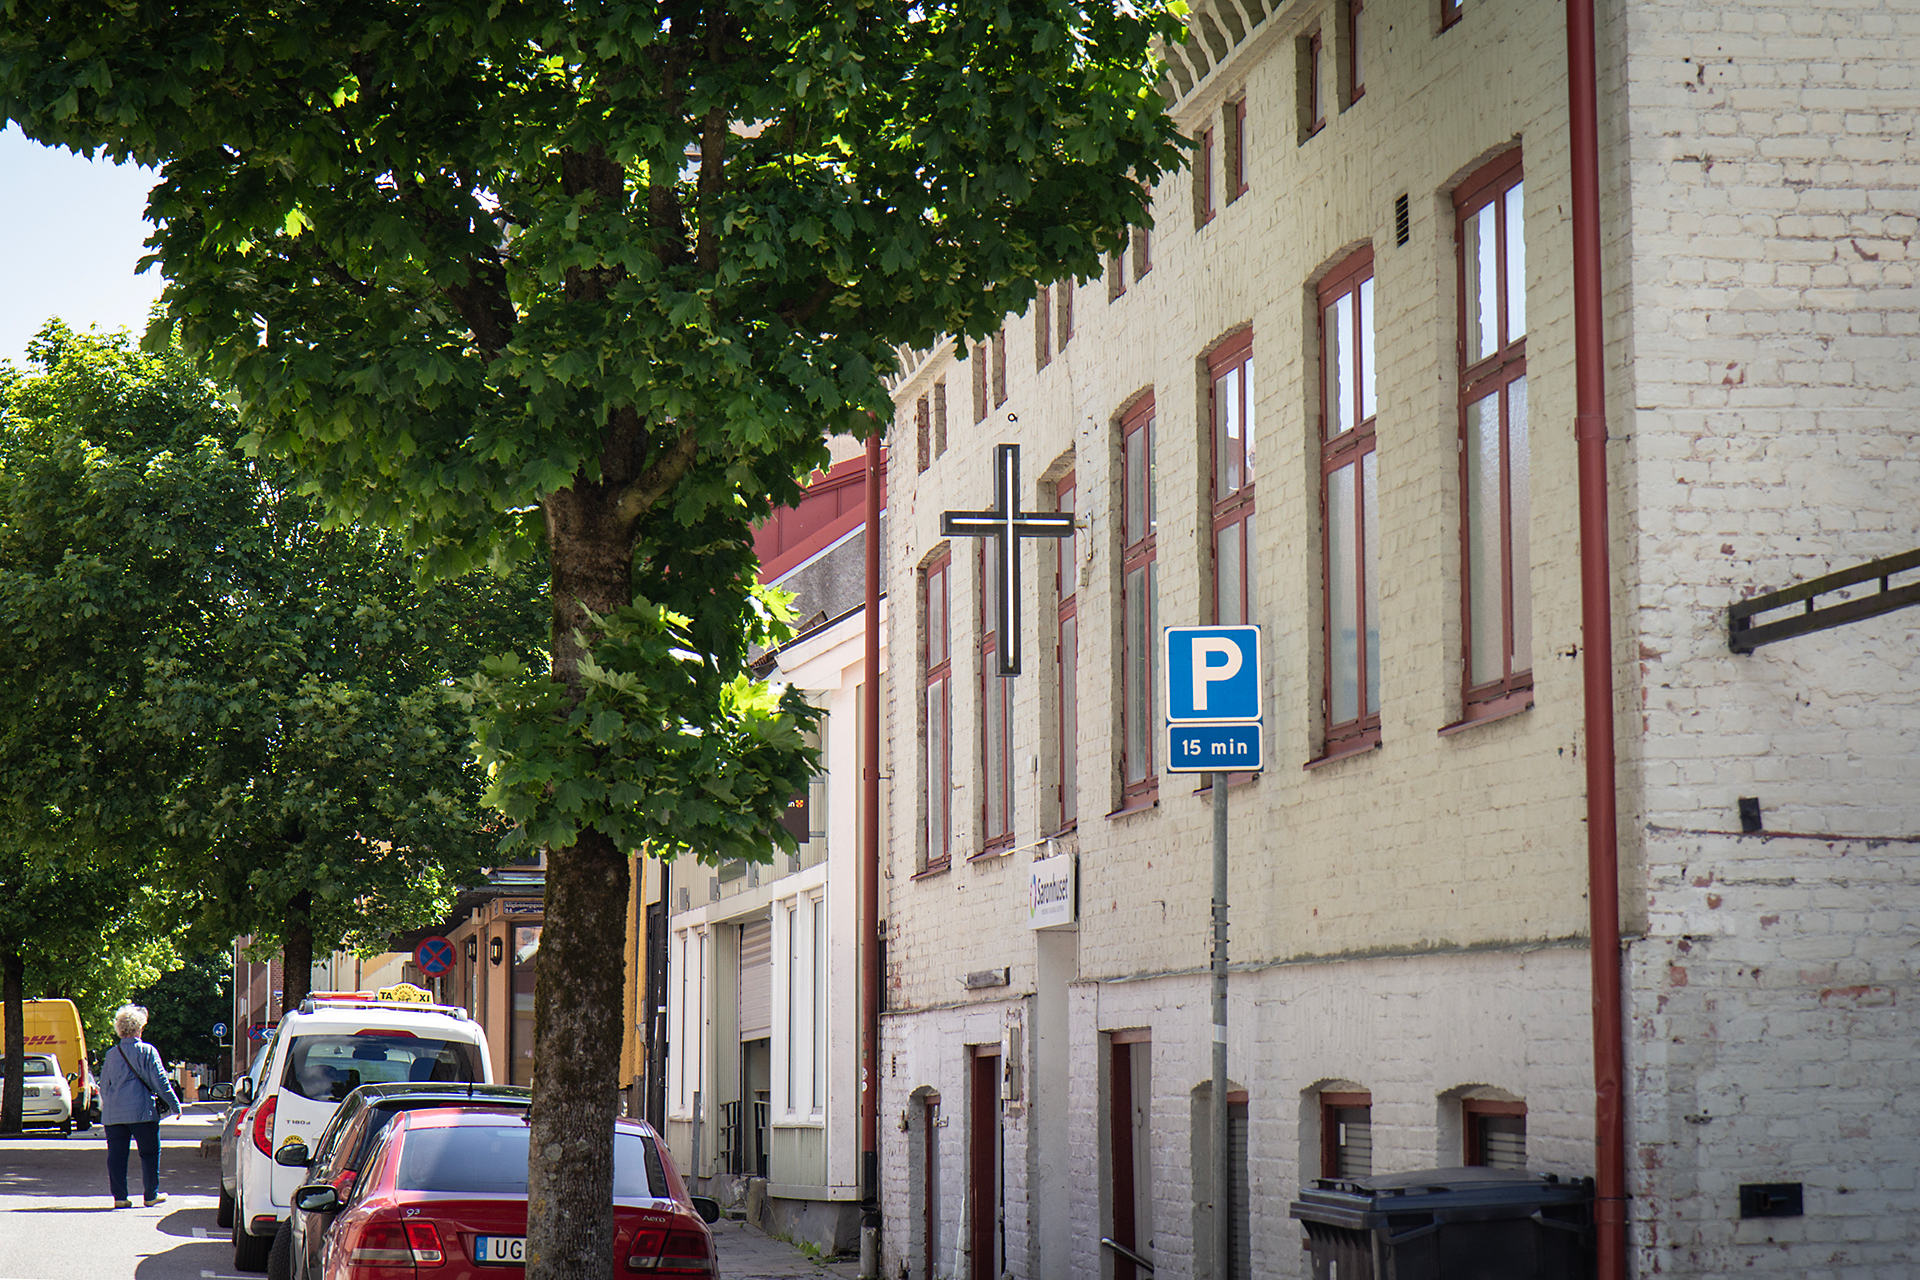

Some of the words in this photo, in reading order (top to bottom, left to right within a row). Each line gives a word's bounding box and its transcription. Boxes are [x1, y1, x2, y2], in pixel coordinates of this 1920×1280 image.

[1192, 637, 1243, 710] P
[1182, 739, 1202, 756] 15
[1211, 738, 1248, 755] min
[1037, 872, 1068, 905] Saronhuset
[380, 991, 393, 1000] TA
[419, 994, 430, 1002] XI
[642, 1215, 666, 1223] Aero
[496, 1239, 527, 1259] UG
